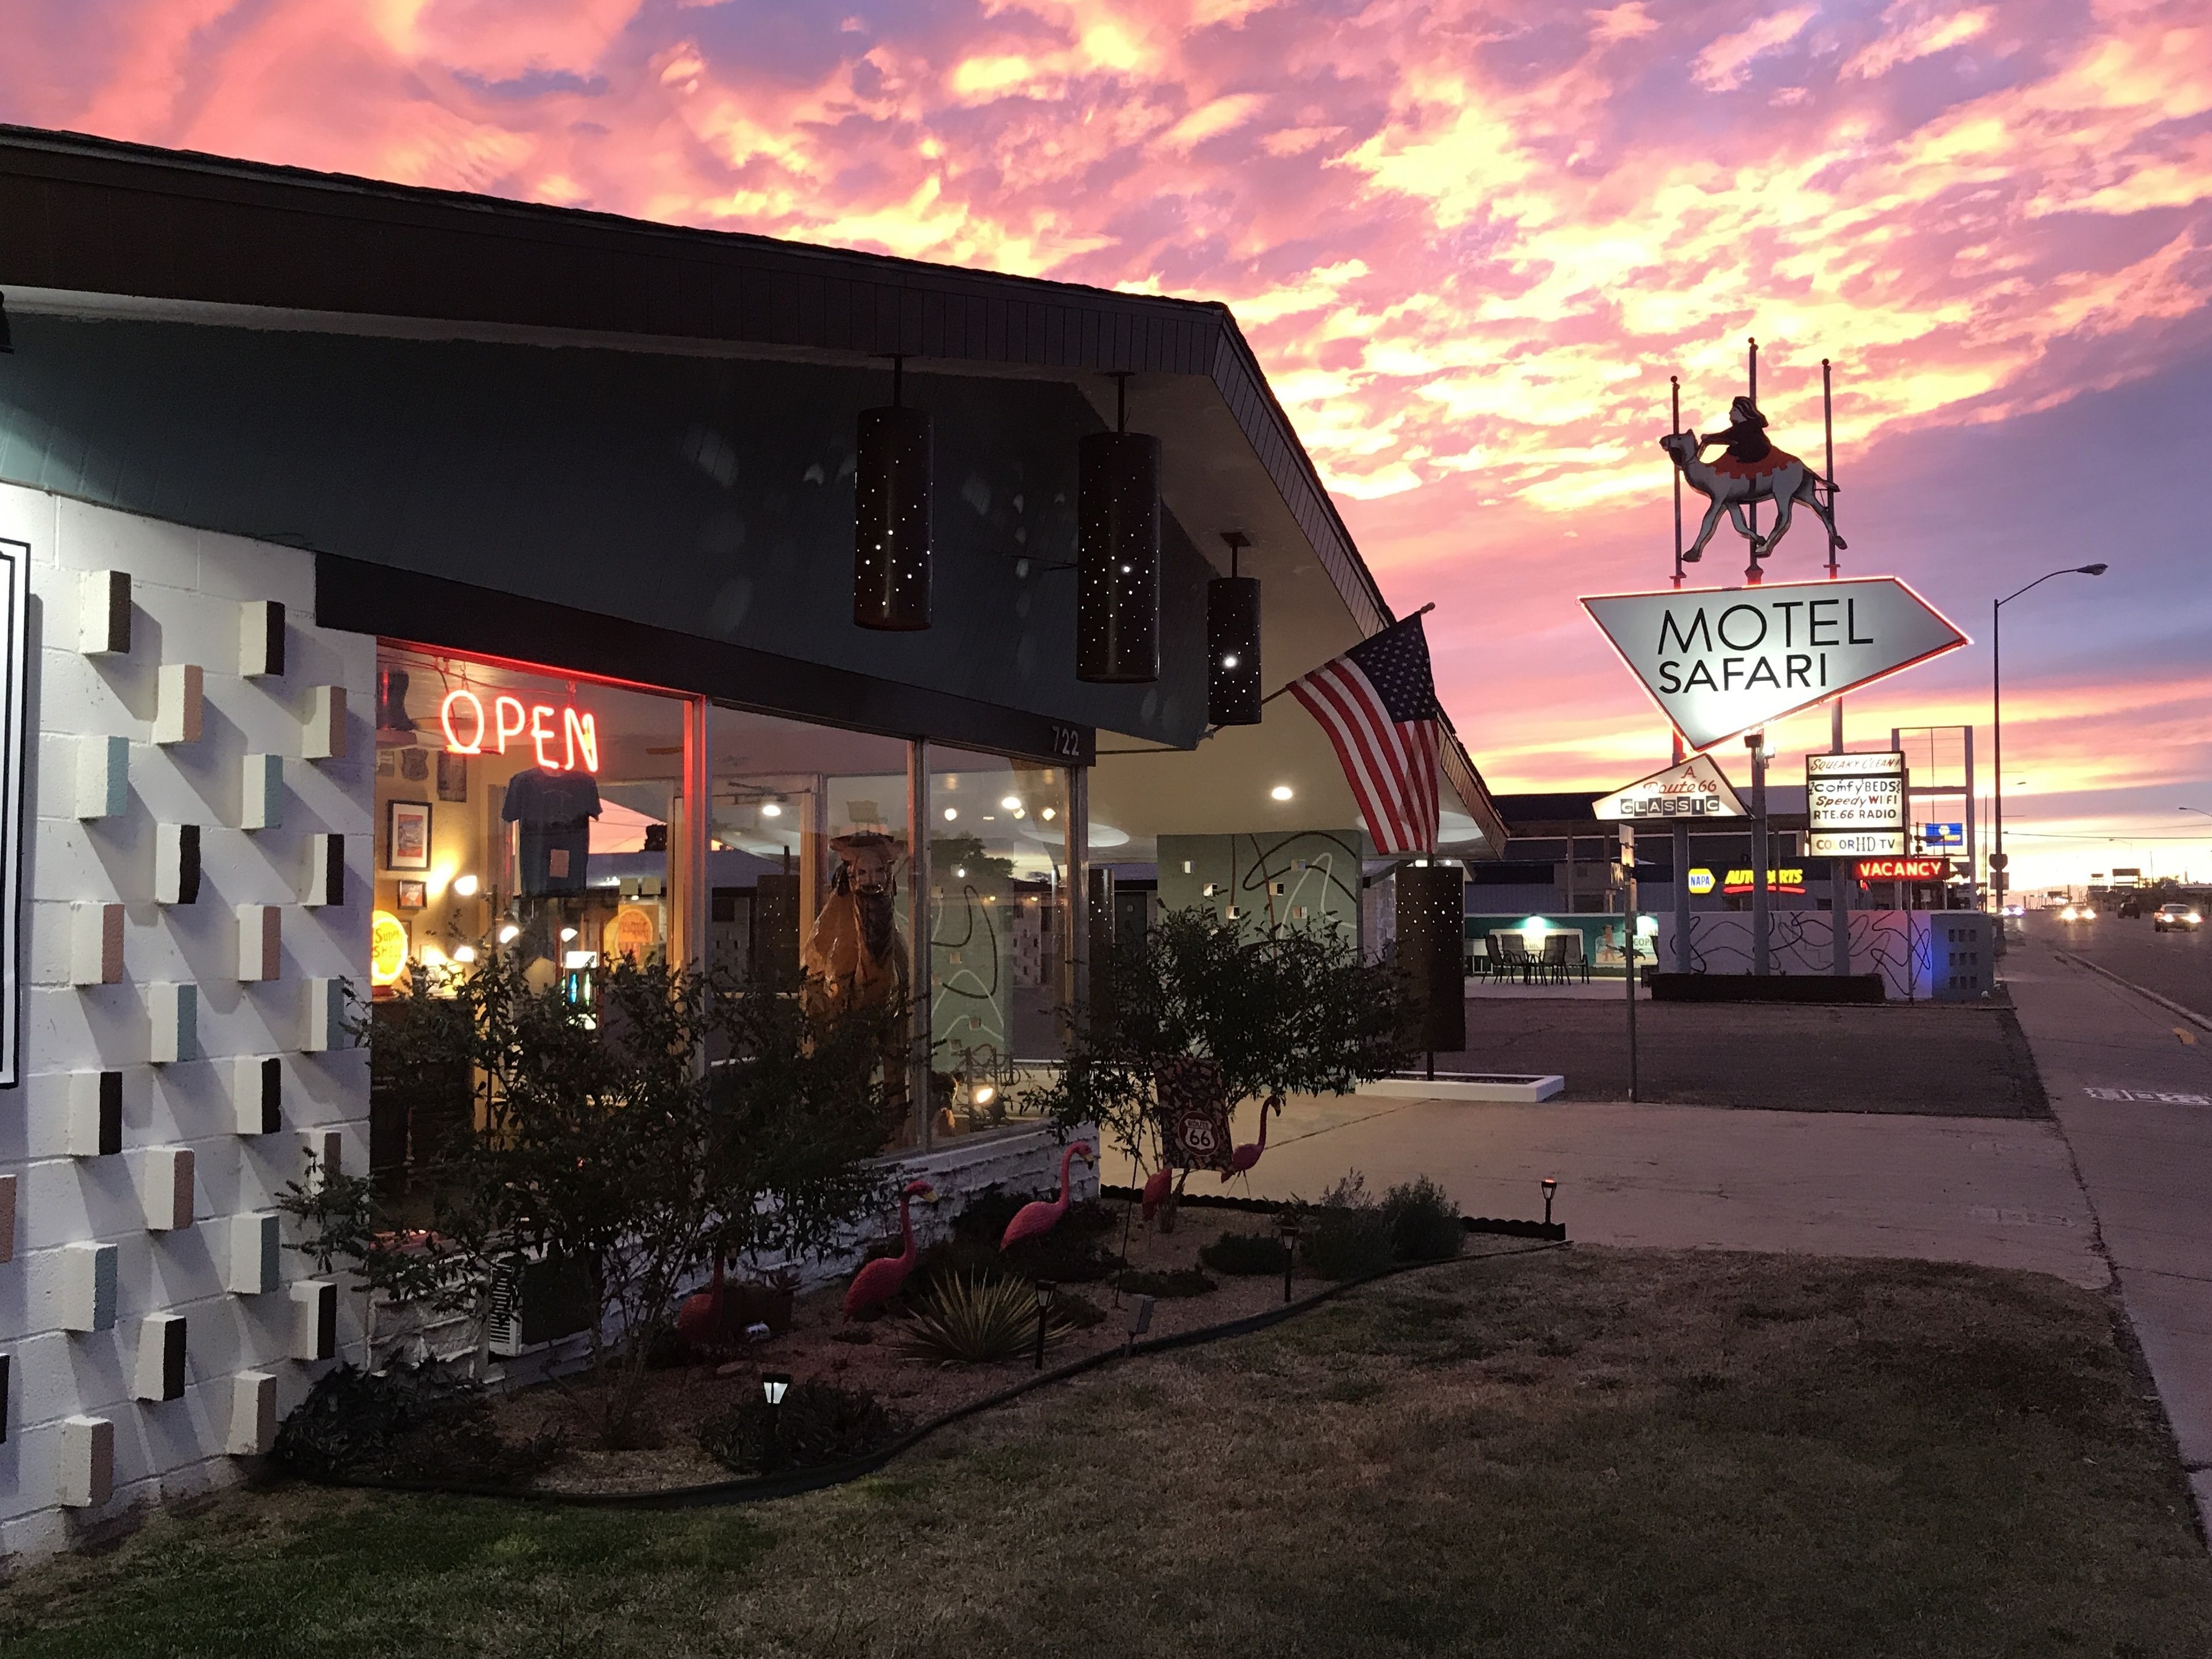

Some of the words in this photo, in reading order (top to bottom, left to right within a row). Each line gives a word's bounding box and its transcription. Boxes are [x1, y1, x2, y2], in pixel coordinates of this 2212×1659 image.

[1657, 598, 1874, 655] MOTEL
[1659, 653, 1826, 694] SAFARI
[441, 690, 599, 772] OPEN
[1052, 725, 1080, 756] 722
[1680, 766, 1697, 778] A
[1643, 781, 1695, 794] Route
[1698, 779, 1717, 793] 66
[1865, 781, 1896, 793] BEDS
[1620, 798, 1719, 815] CLASSIC
[1816, 796, 1866, 808] Speedy
[1859, 809, 1896, 819] RADIO
[1860, 862, 1942, 876] VACANCY
[1690, 876, 1710, 886] NAPA
[1190, 1130, 1211, 1146] 66
